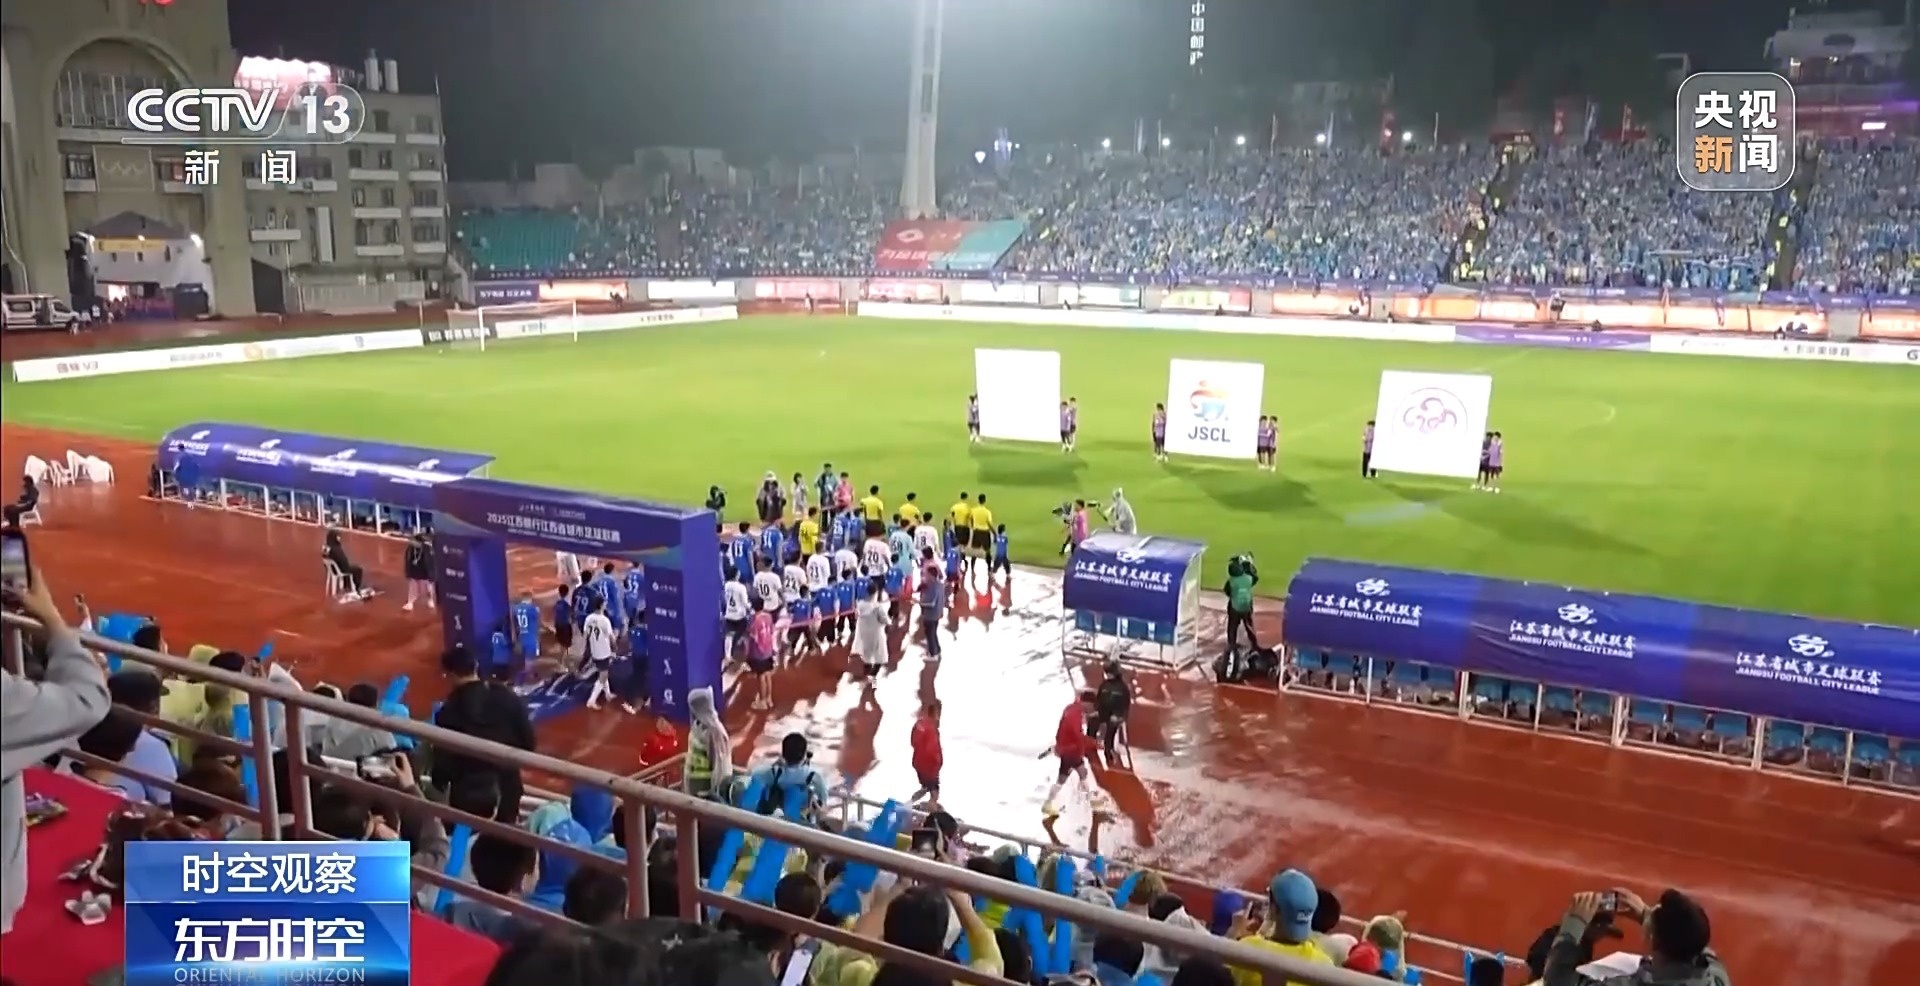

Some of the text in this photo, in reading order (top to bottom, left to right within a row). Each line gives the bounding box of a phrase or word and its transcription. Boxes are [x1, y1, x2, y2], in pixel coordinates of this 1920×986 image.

[1187, 425, 1231, 443] JSCL
[1509, 619, 1637, 650] 江苏省城市足球联赛
[1735, 651, 1882, 686] 江苏省城市足球联赛
